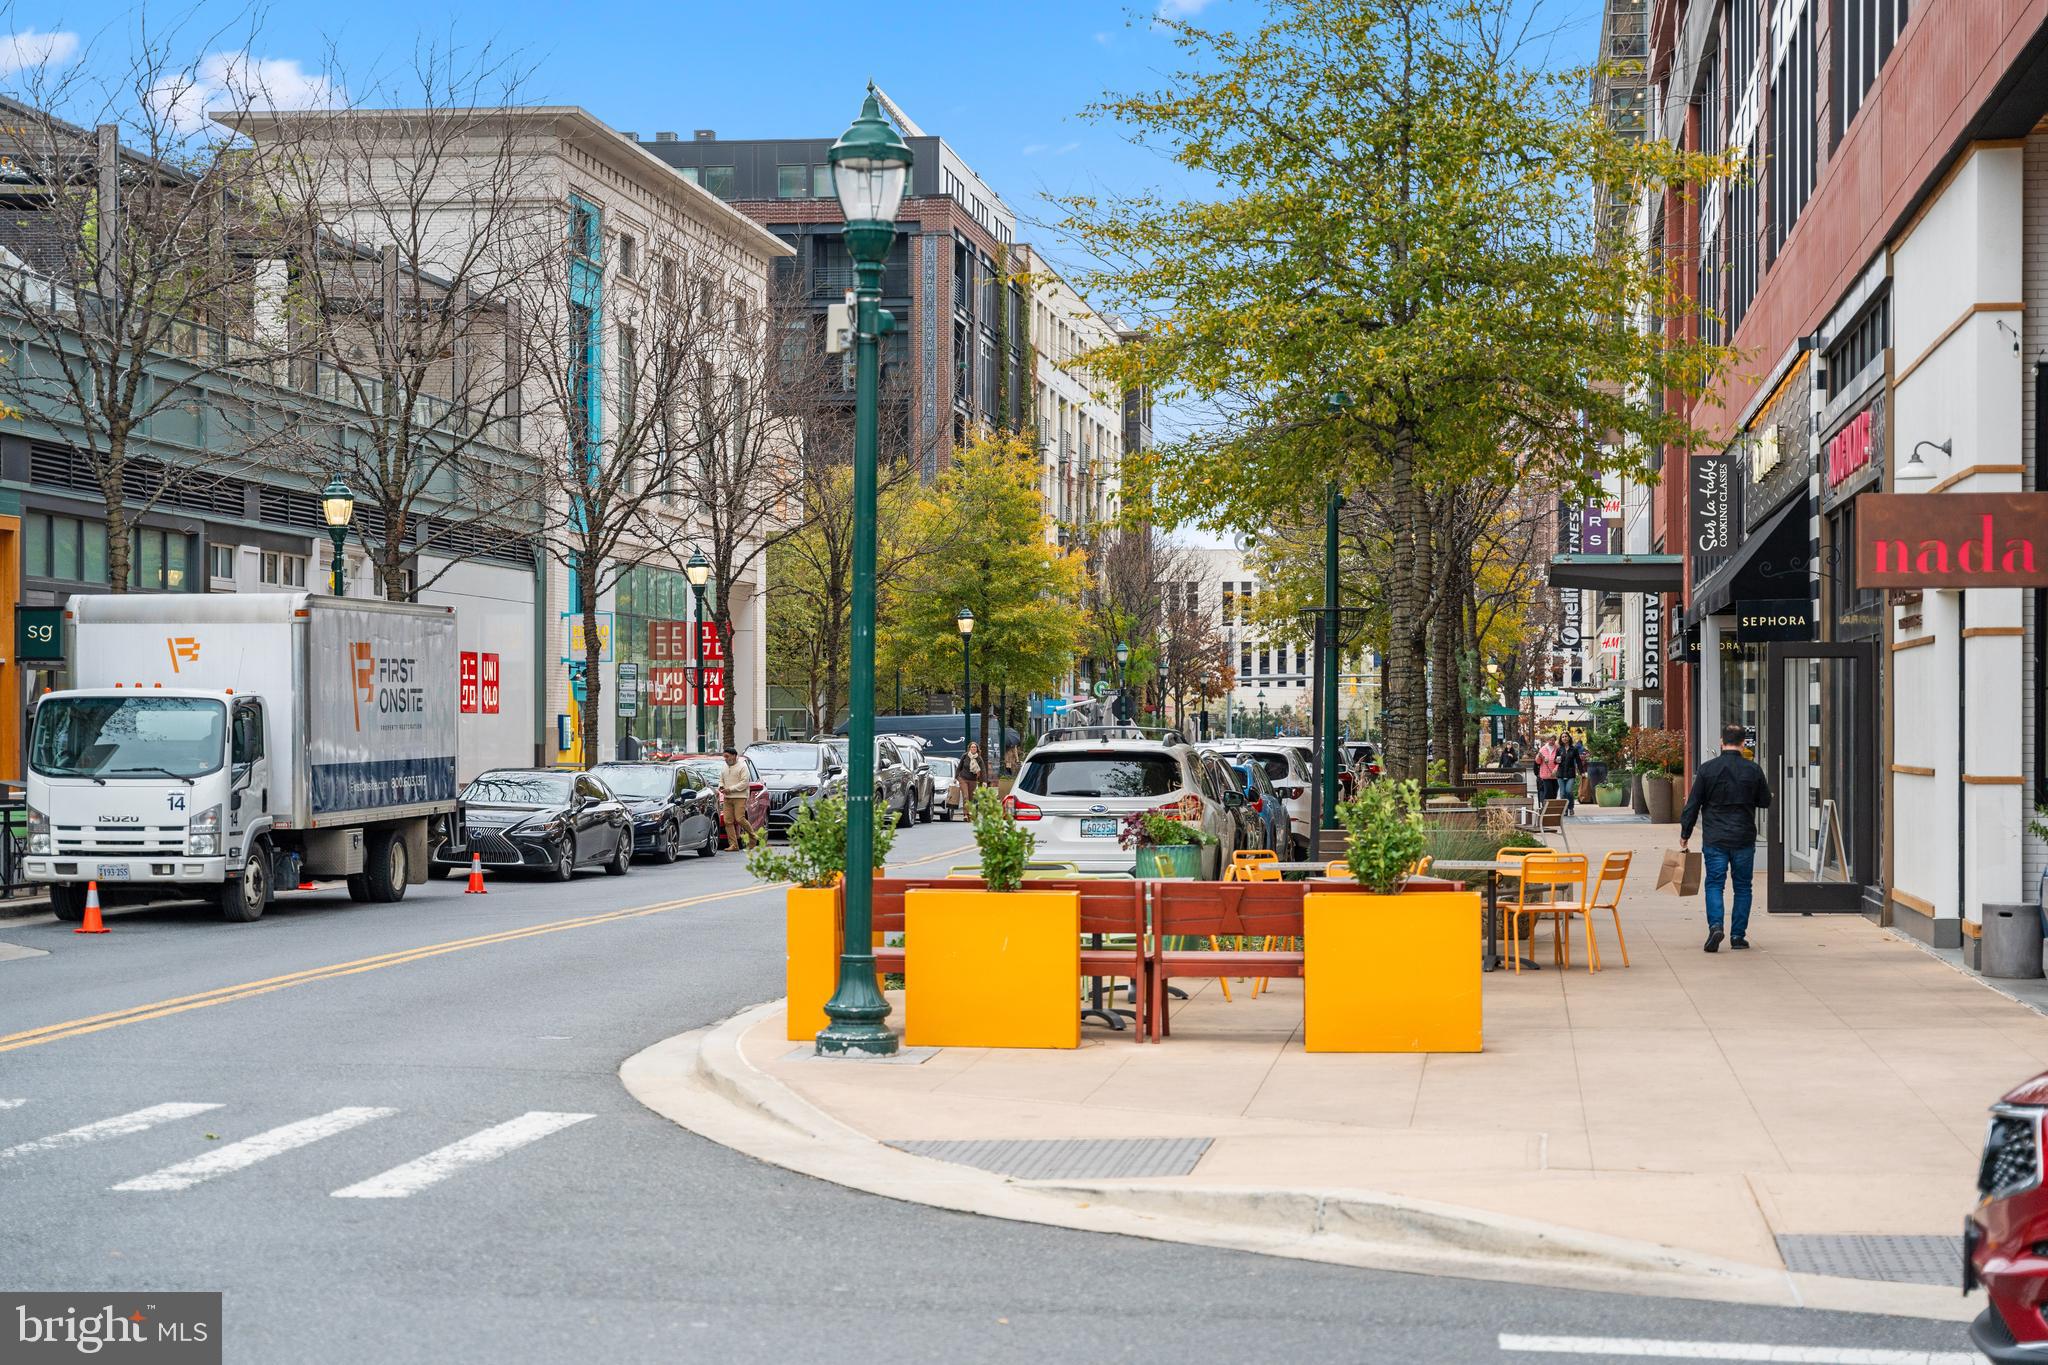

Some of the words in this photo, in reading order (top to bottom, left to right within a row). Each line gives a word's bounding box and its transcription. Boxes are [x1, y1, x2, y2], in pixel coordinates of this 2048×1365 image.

[1699, 459, 1718, 499] table
[1719, 463, 1727, 502] CLASSES
[1699, 519, 1718, 551] Sur
[1719, 503, 1727, 547] COOKING
[1871, 512, 2039, 574] nada
[1742, 615, 1806, 627] SEPHORA
[27, 625, 53, 642] sg
[380, 658, 416, 683] FIRST
[483, 660, 497, 682] UNI
[380, 687, 424, 713] ONSITE
[483, 685, 498, 709] QLO
[167, 796, 186, 811] 14
[98, 815, 140, 823] ISUZU
[230, 812, 239, 828] 14
